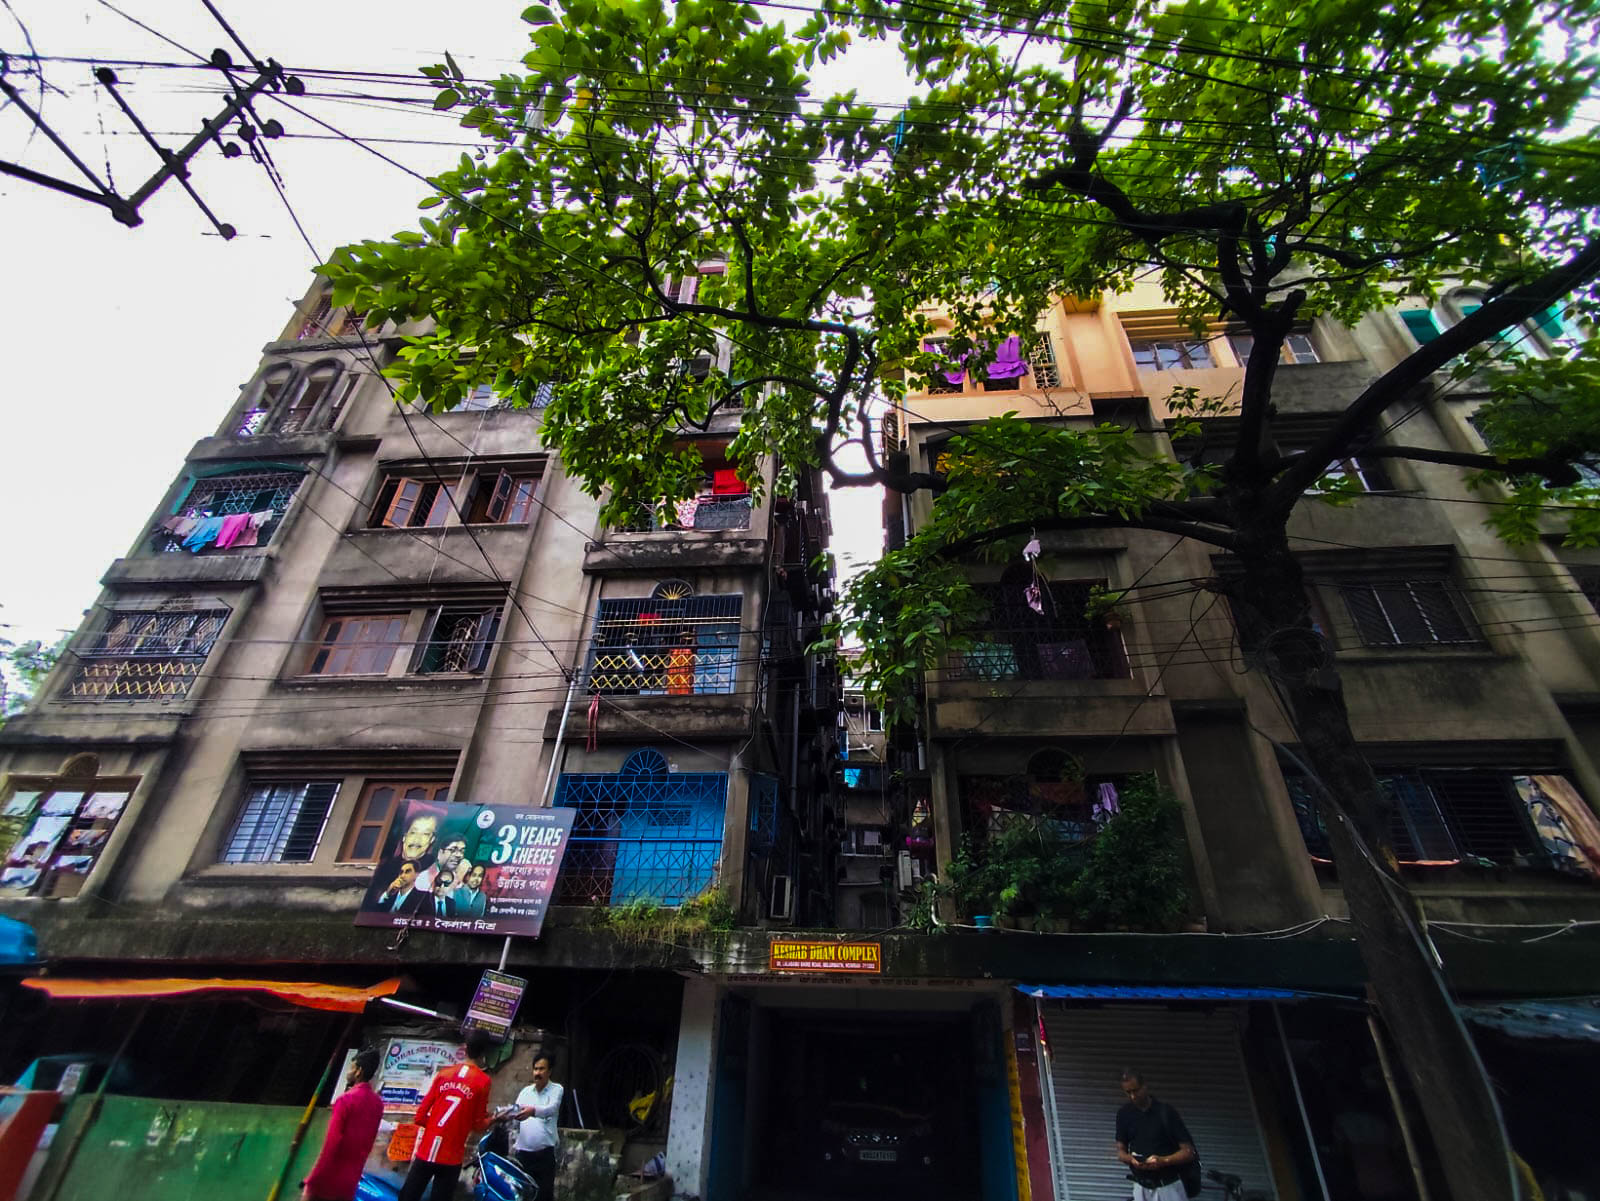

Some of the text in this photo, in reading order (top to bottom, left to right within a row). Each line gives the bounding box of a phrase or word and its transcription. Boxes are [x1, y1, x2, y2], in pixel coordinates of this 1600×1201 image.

[491, 824, 563, 865] 3 YEARS
[511, 846, 556, 866] CHEERS
[773, 943, 878, 961] KESHAB DHAM COMPLEX
[440, 1082, 473, 1099] RONALDO
[437, 1095, 461, 1127] 7
